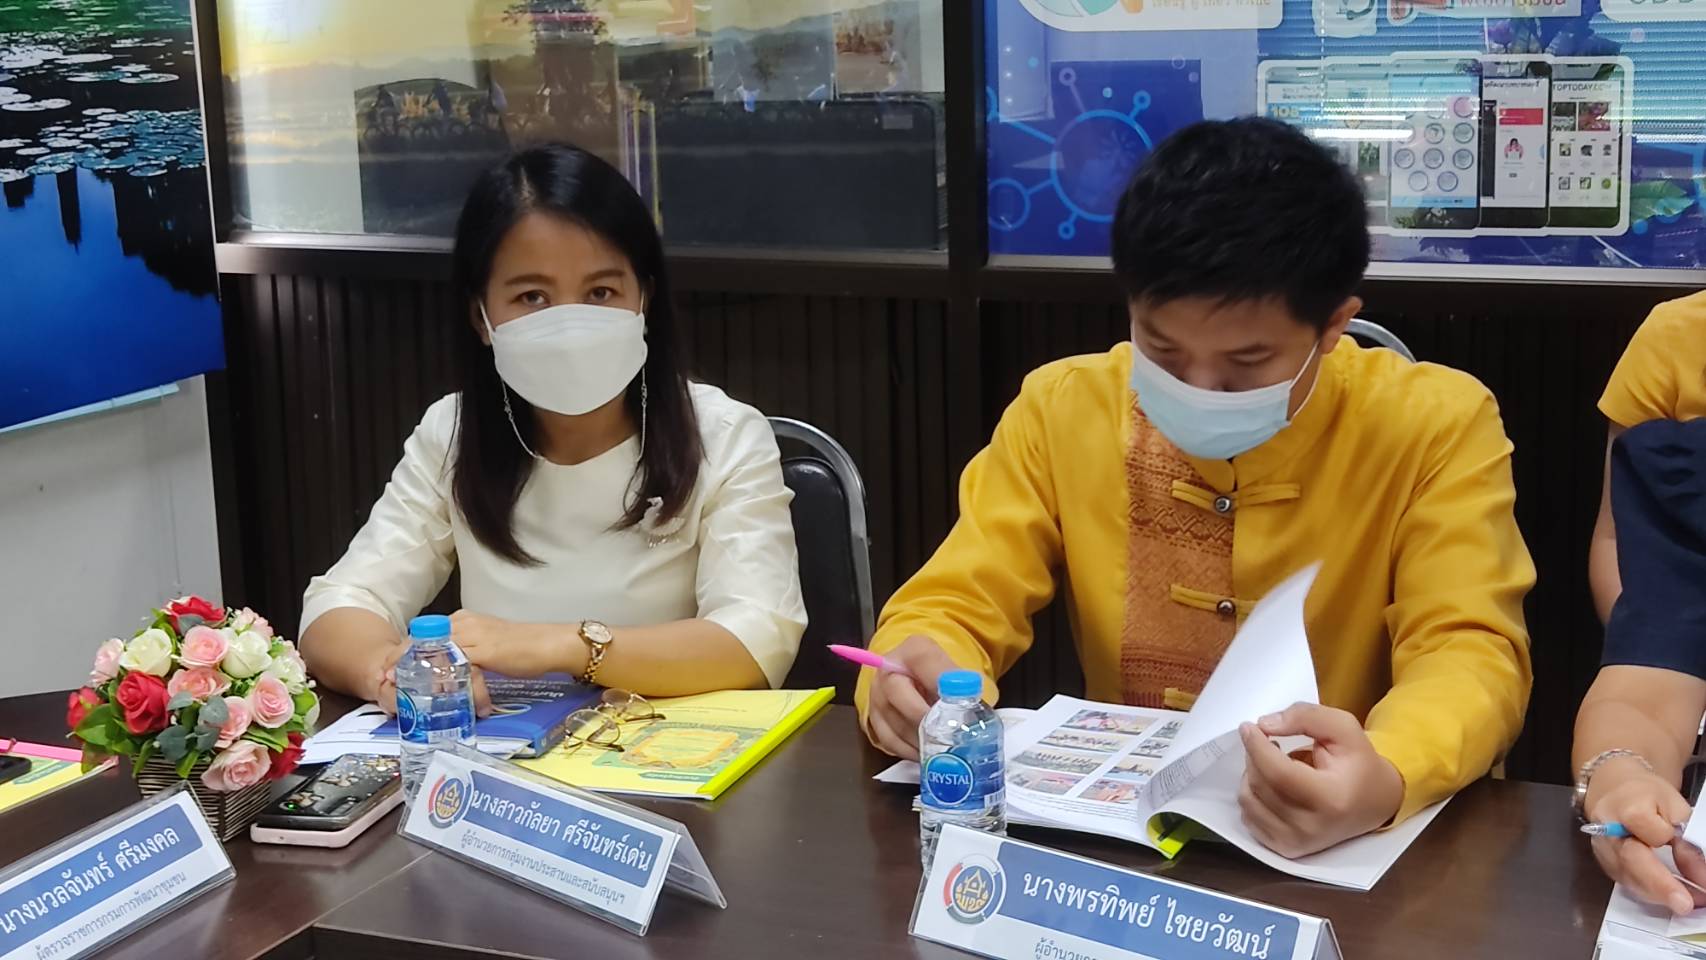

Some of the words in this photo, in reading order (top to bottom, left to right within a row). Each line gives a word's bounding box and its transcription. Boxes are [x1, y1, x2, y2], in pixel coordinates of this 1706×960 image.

[399, 706, 414, 720] STAL
[927, 770, 970, 786] CRYSTAL
[471, 790, 560, 837] นางสาวกัลยา
[562, 819, 652, 871] ศรีจันทร์เด่น
[0, 851, 115, 934] นางนวลจันทร์
[115, 827, 180, 872] ศรีมงคล
[35, 871, 187, 960] ผ้ตรวจราชการกรมการพัฒนาชุมชน
[1022, 872, 1160, 928] นางพรทิพย์
[1164, 897, 1276, 960] ไชยวัฒน์
